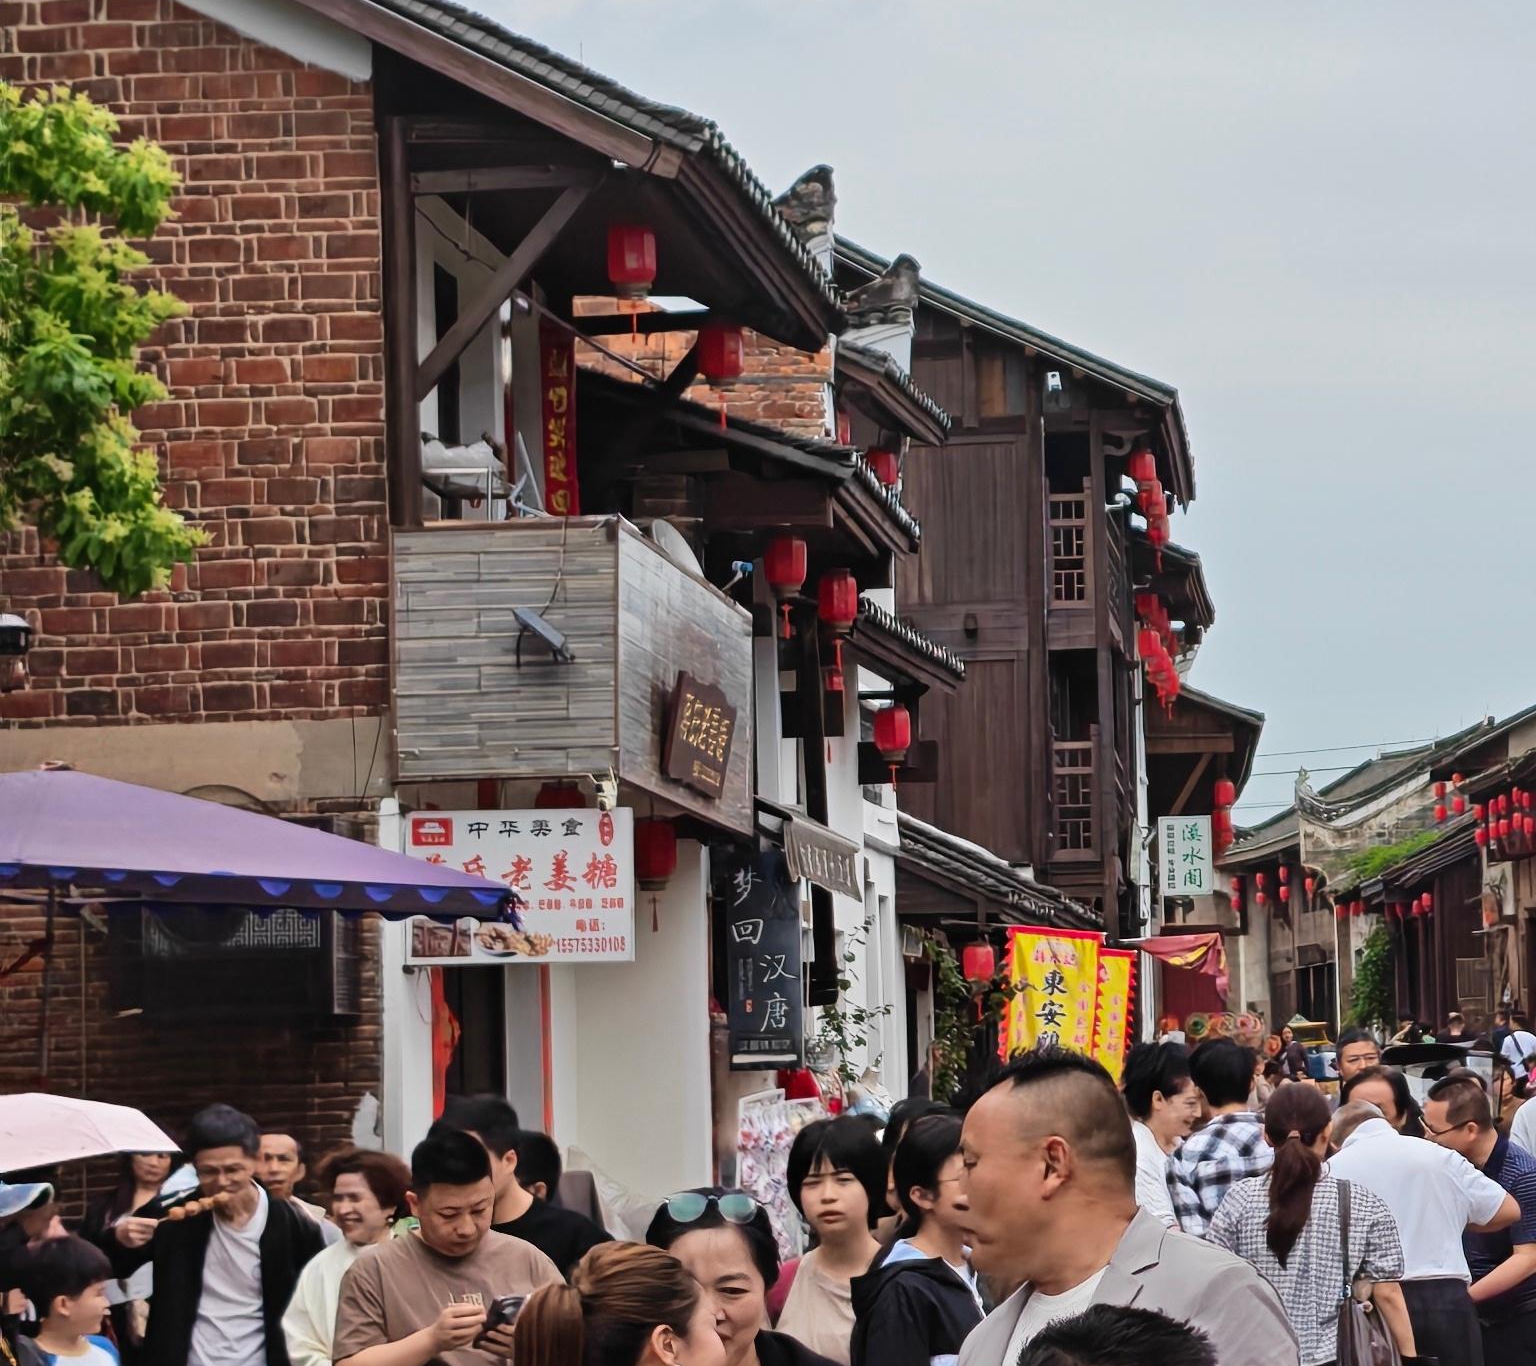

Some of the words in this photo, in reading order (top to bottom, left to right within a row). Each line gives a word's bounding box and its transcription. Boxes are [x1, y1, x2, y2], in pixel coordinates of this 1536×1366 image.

[467, 817, 584, 839] 中华美食
[760, 953, 798, 1033] 汉唐
